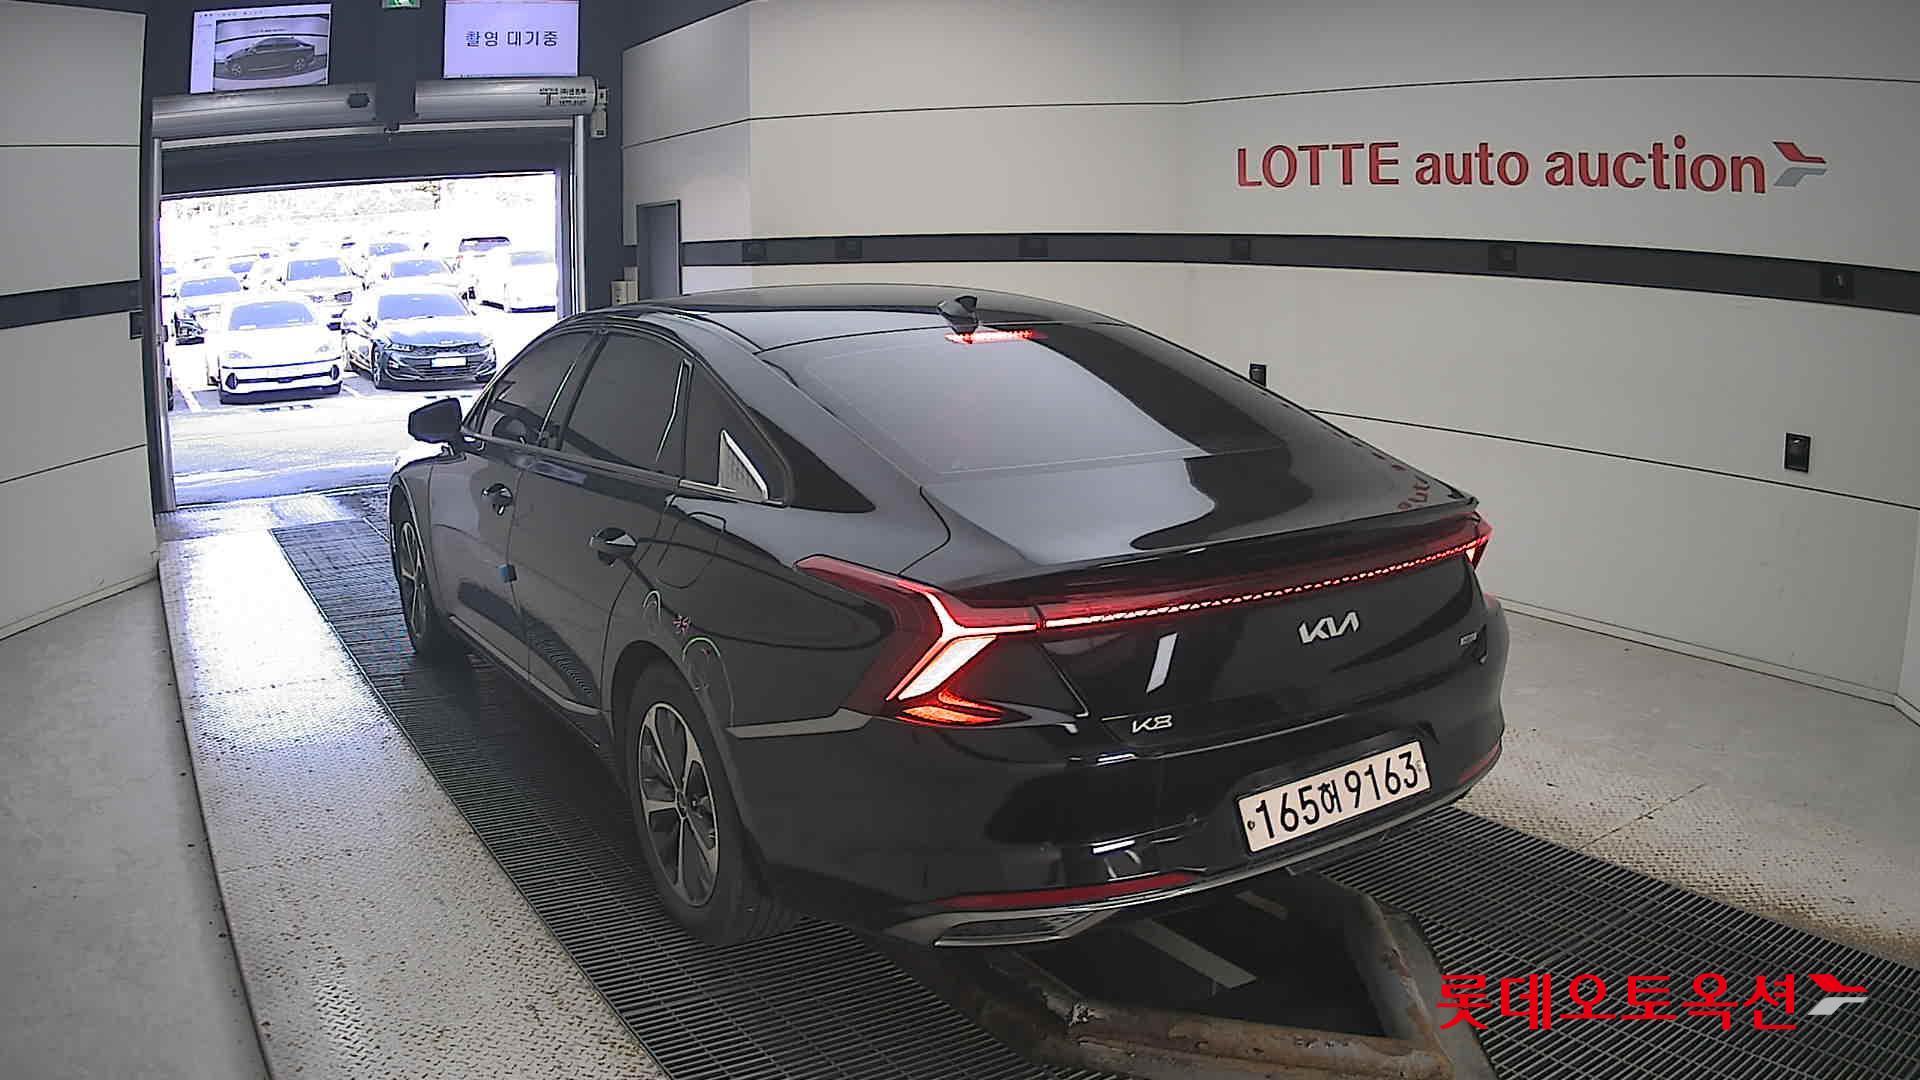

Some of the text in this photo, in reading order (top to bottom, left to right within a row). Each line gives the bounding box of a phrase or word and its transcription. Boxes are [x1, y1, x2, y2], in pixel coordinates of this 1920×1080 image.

[1237, 134, 1767, 194] LOTTE auto auction
[1298, 611, 1360, 644] KIA
[1131, 714, 1173, 734] K8
